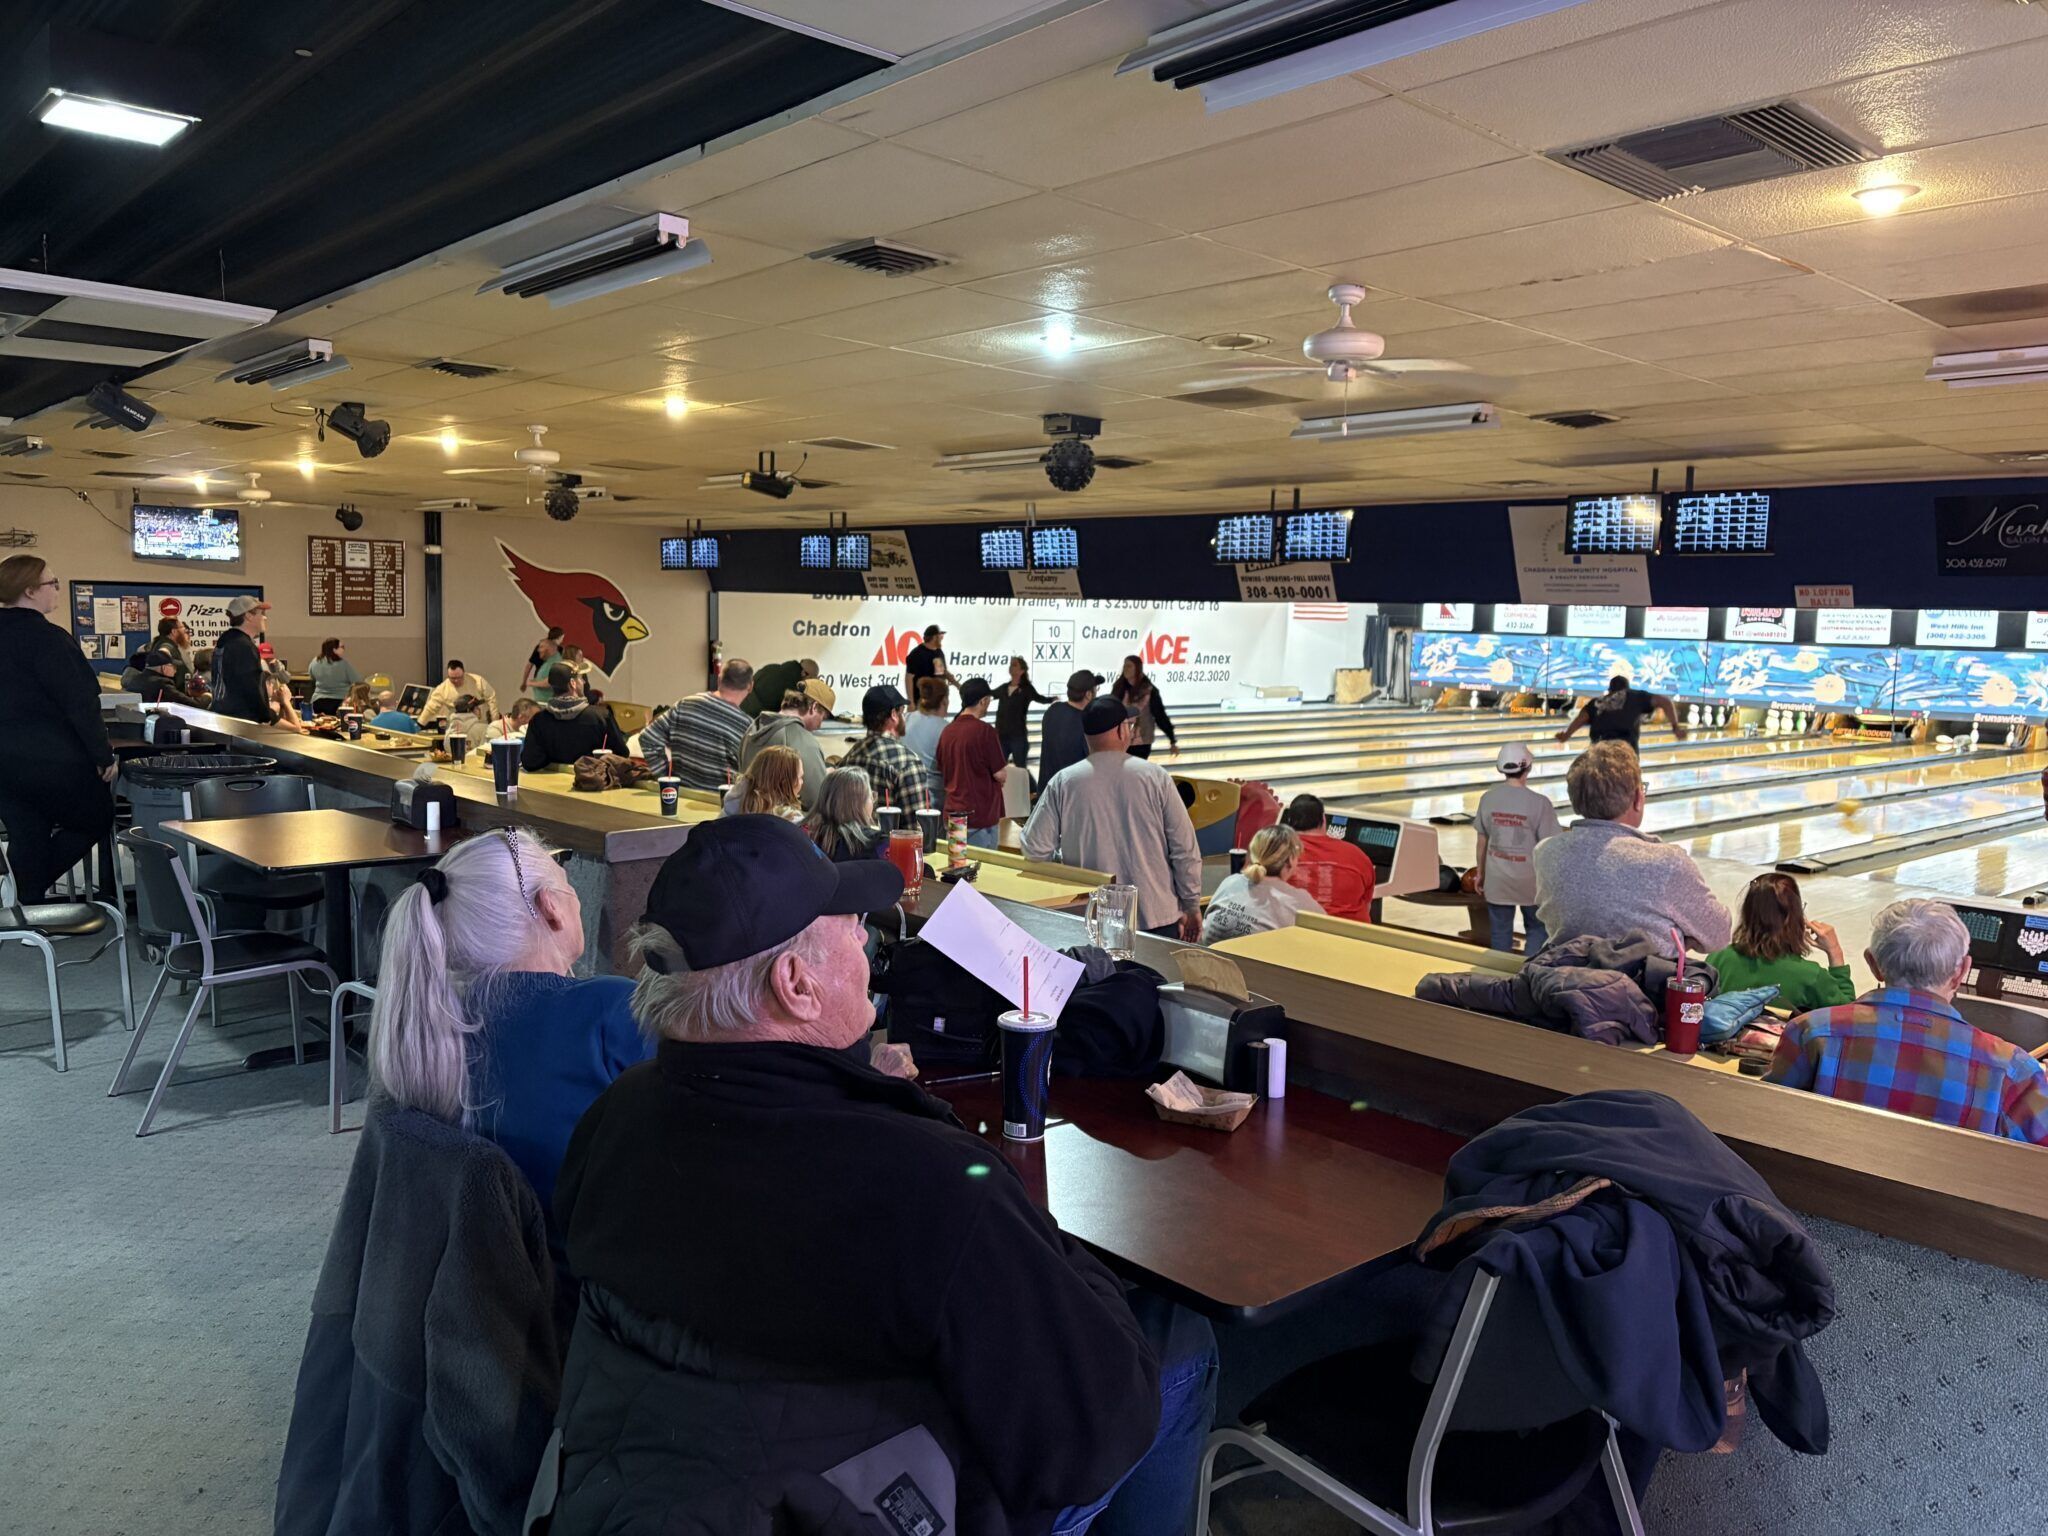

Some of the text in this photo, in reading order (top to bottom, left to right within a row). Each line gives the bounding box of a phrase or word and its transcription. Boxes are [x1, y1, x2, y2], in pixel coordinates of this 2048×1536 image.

[1946, 558, 2007, 569] 308.432.8977
[1027, 574, 1058, 584] Company
[1246, 586, 1330, 598] 308-430-0001
[1810, 598, 1840, 607] BALLS
[187, 604, 223, 617] Pizza
[792, 620, 871, 637] Chadron
[1049, 626, 1061, 638] 10
[1082, 626, 1138, 640] Chadron
[871, 625, 923, 666] AC
[1140, 630, 1190, 665] ACE
[1035, 645, 1071, 659] X X X
[949, 652, 1024, 665] Hardwa
[1194, 653, 1231, 665] Annex
[840, 673, 872, 688] West
[878, 673, 900, 687] 3rd
[1166, 670, 1231, 683] 308.432.3020
[1459, 682, 1492, 691] Brunswick
[1770, 701, 1816, 712] Brunswick
[1973, 713, 2027, 724] Brunswick
[1833, 727, 1893, 738] METAL PRODUCT
[1228, 901, 1245, 912] 2024
[1227, 909, 1258, 923] QUALIFIERS
